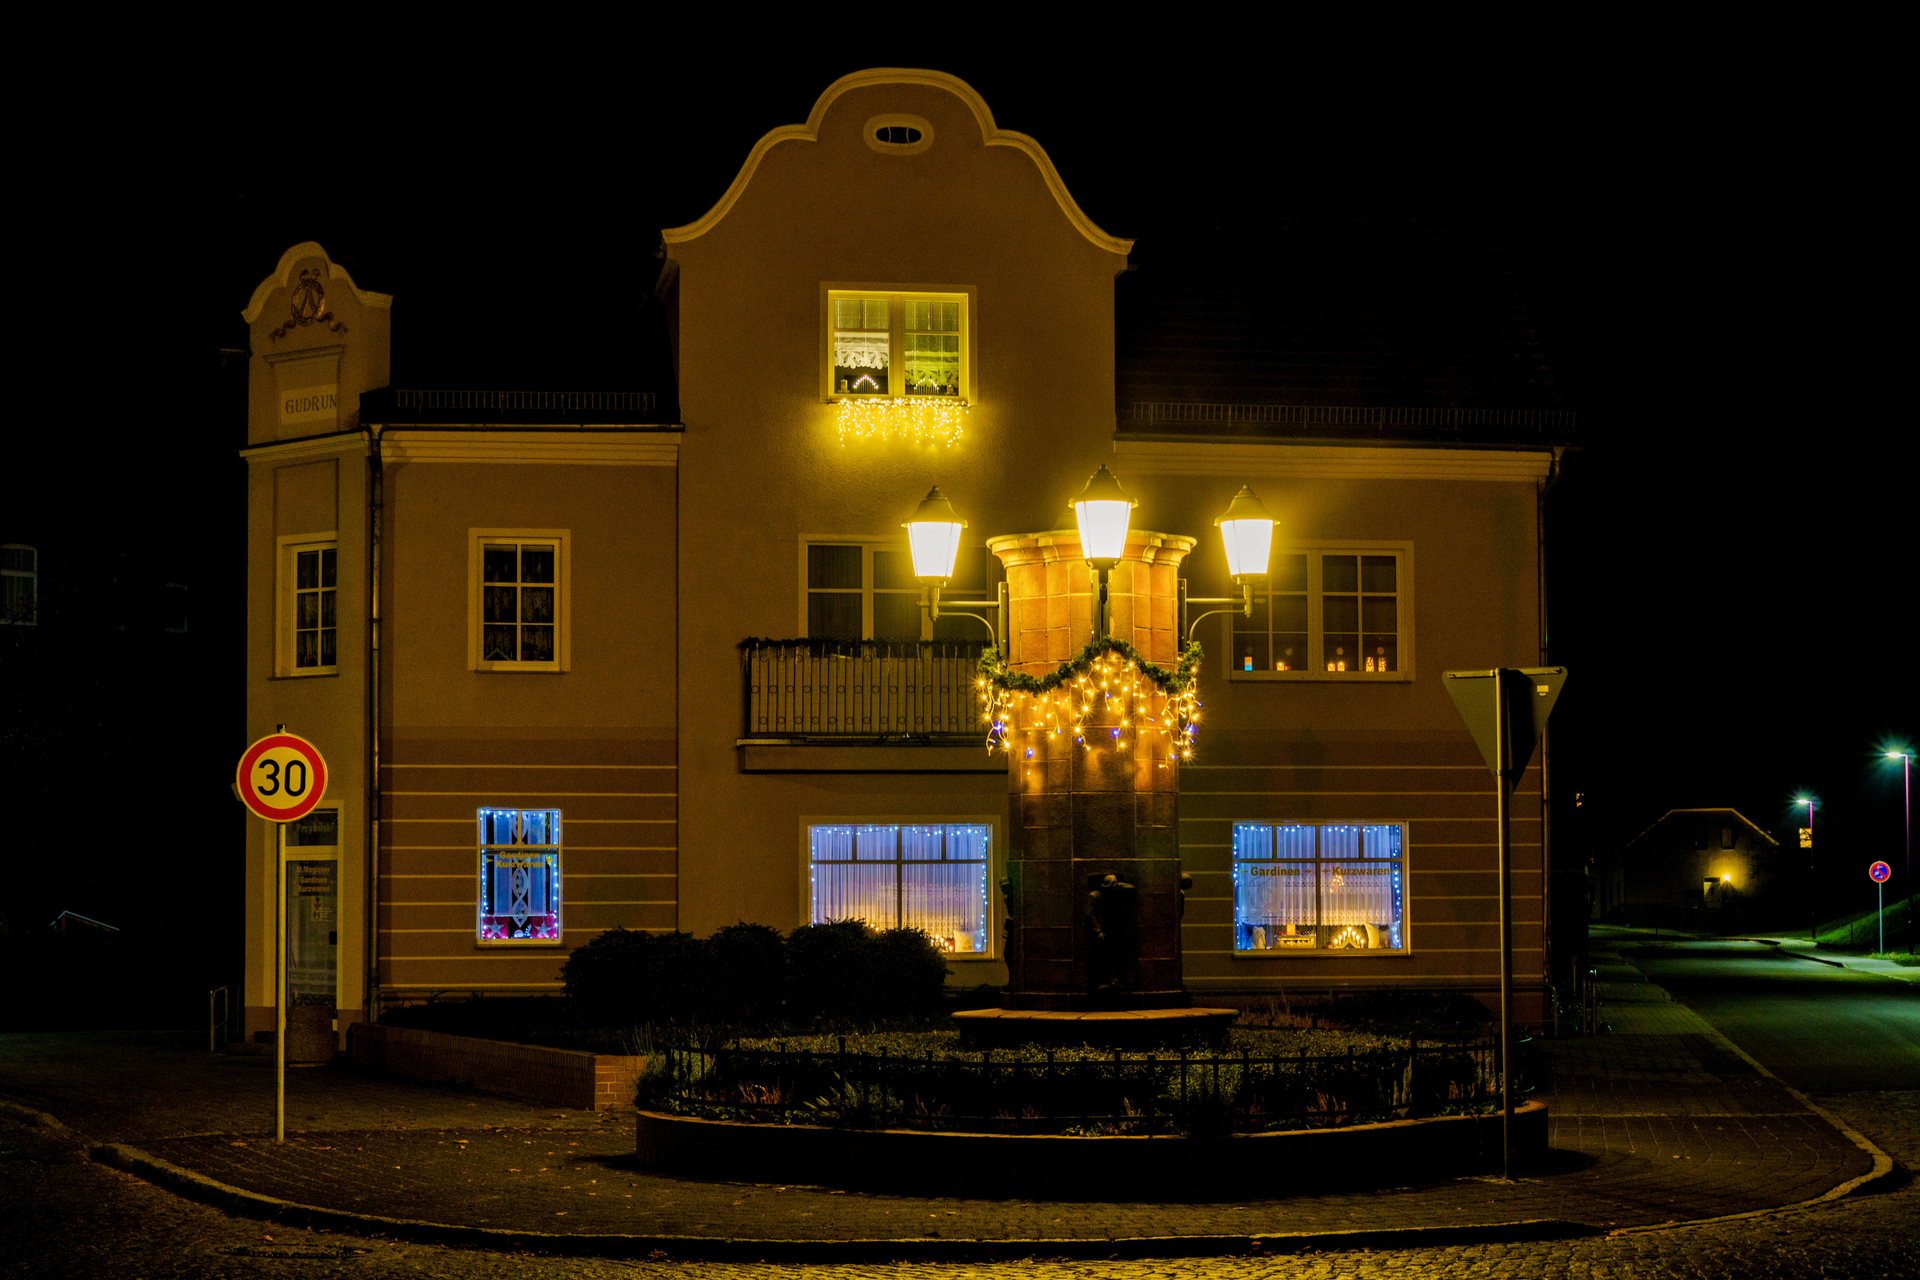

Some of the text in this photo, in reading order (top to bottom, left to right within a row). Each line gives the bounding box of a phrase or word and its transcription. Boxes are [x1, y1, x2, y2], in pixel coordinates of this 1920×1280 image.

[285, 394, 337, 414] GUDRUN
[258, 759, 306, 797] 30
[499, 851, 541, 859] Gardinen
[495, 860, 544, 868] Kurzwaren
[1250, 866, 1391, 877] Gardinen Kurzwaren
